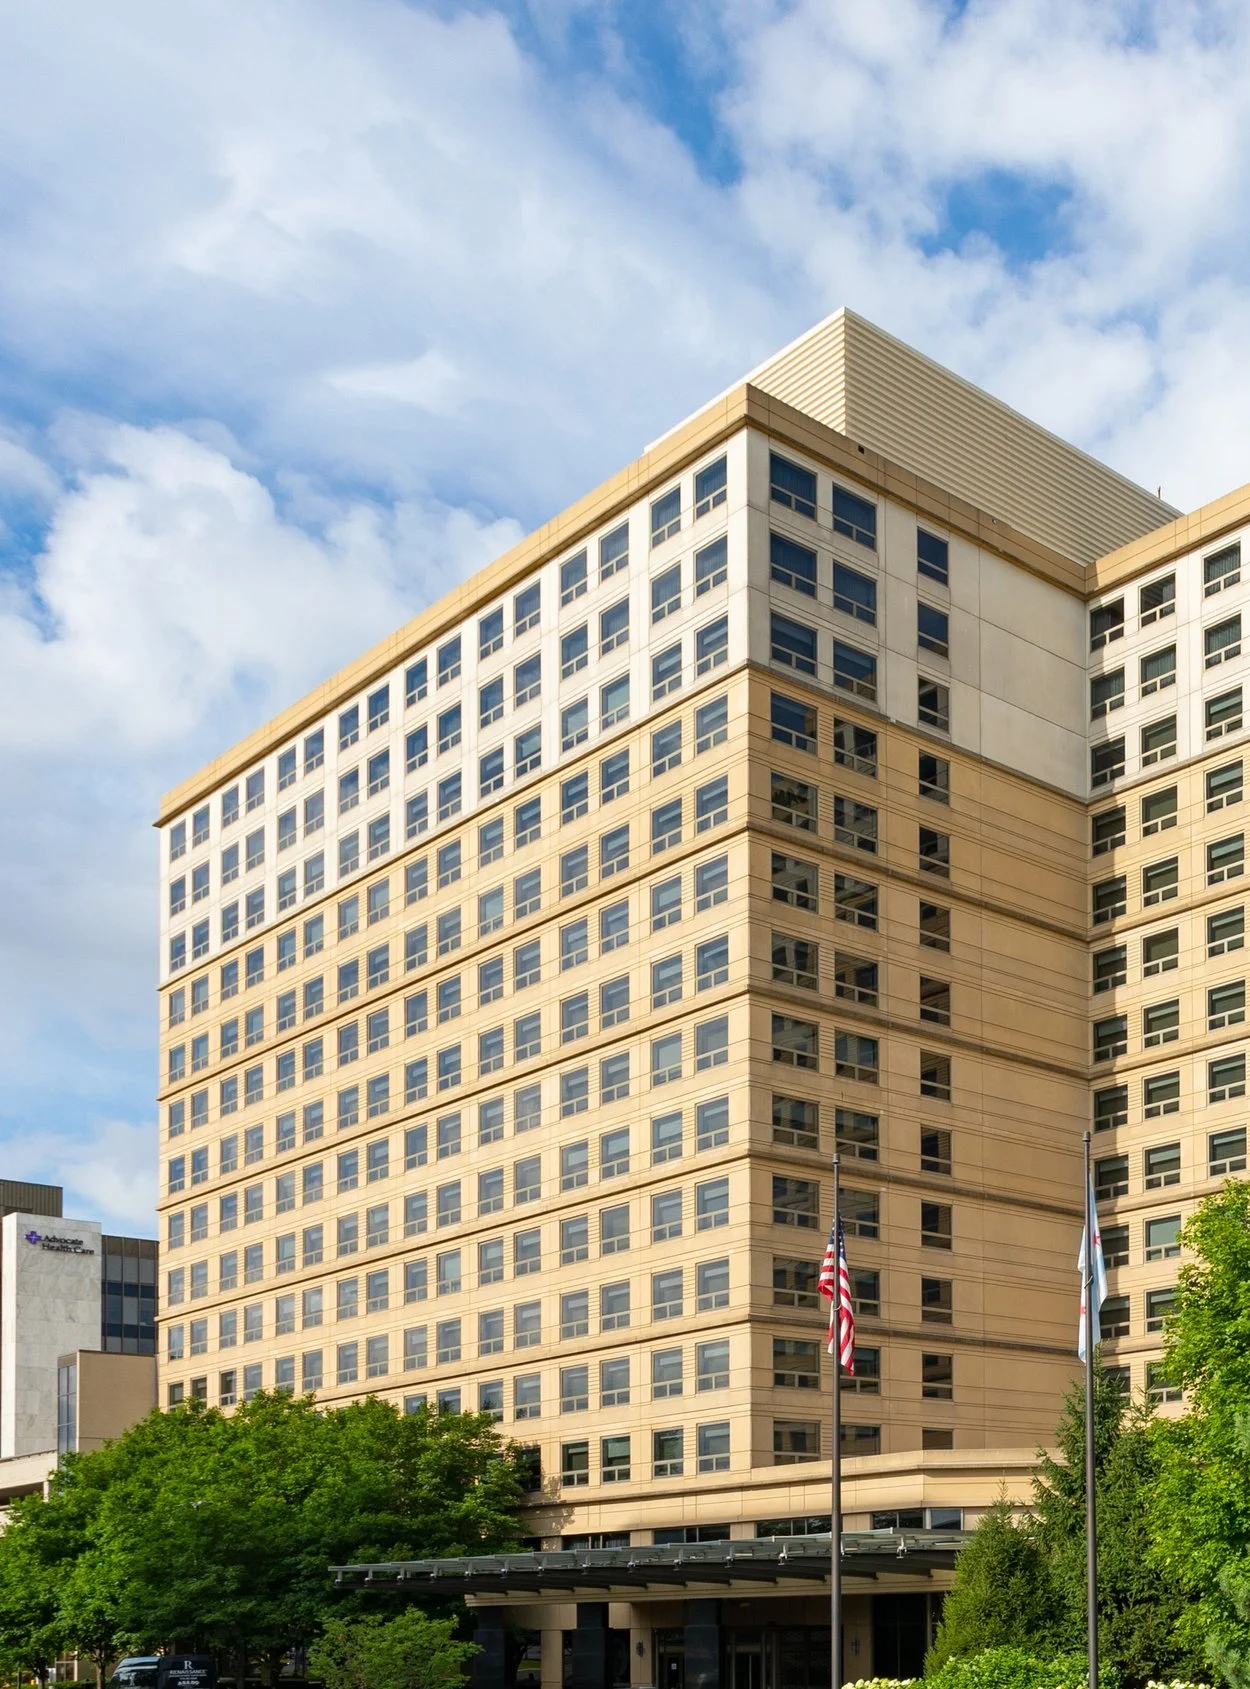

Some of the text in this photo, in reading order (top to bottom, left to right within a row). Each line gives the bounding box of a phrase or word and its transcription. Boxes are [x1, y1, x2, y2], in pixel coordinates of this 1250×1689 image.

[43, 1235, 83, 1245] Advocate
[42, 1243, 94, 1255] Health Care
[184, 1660, 194, 1669] R
